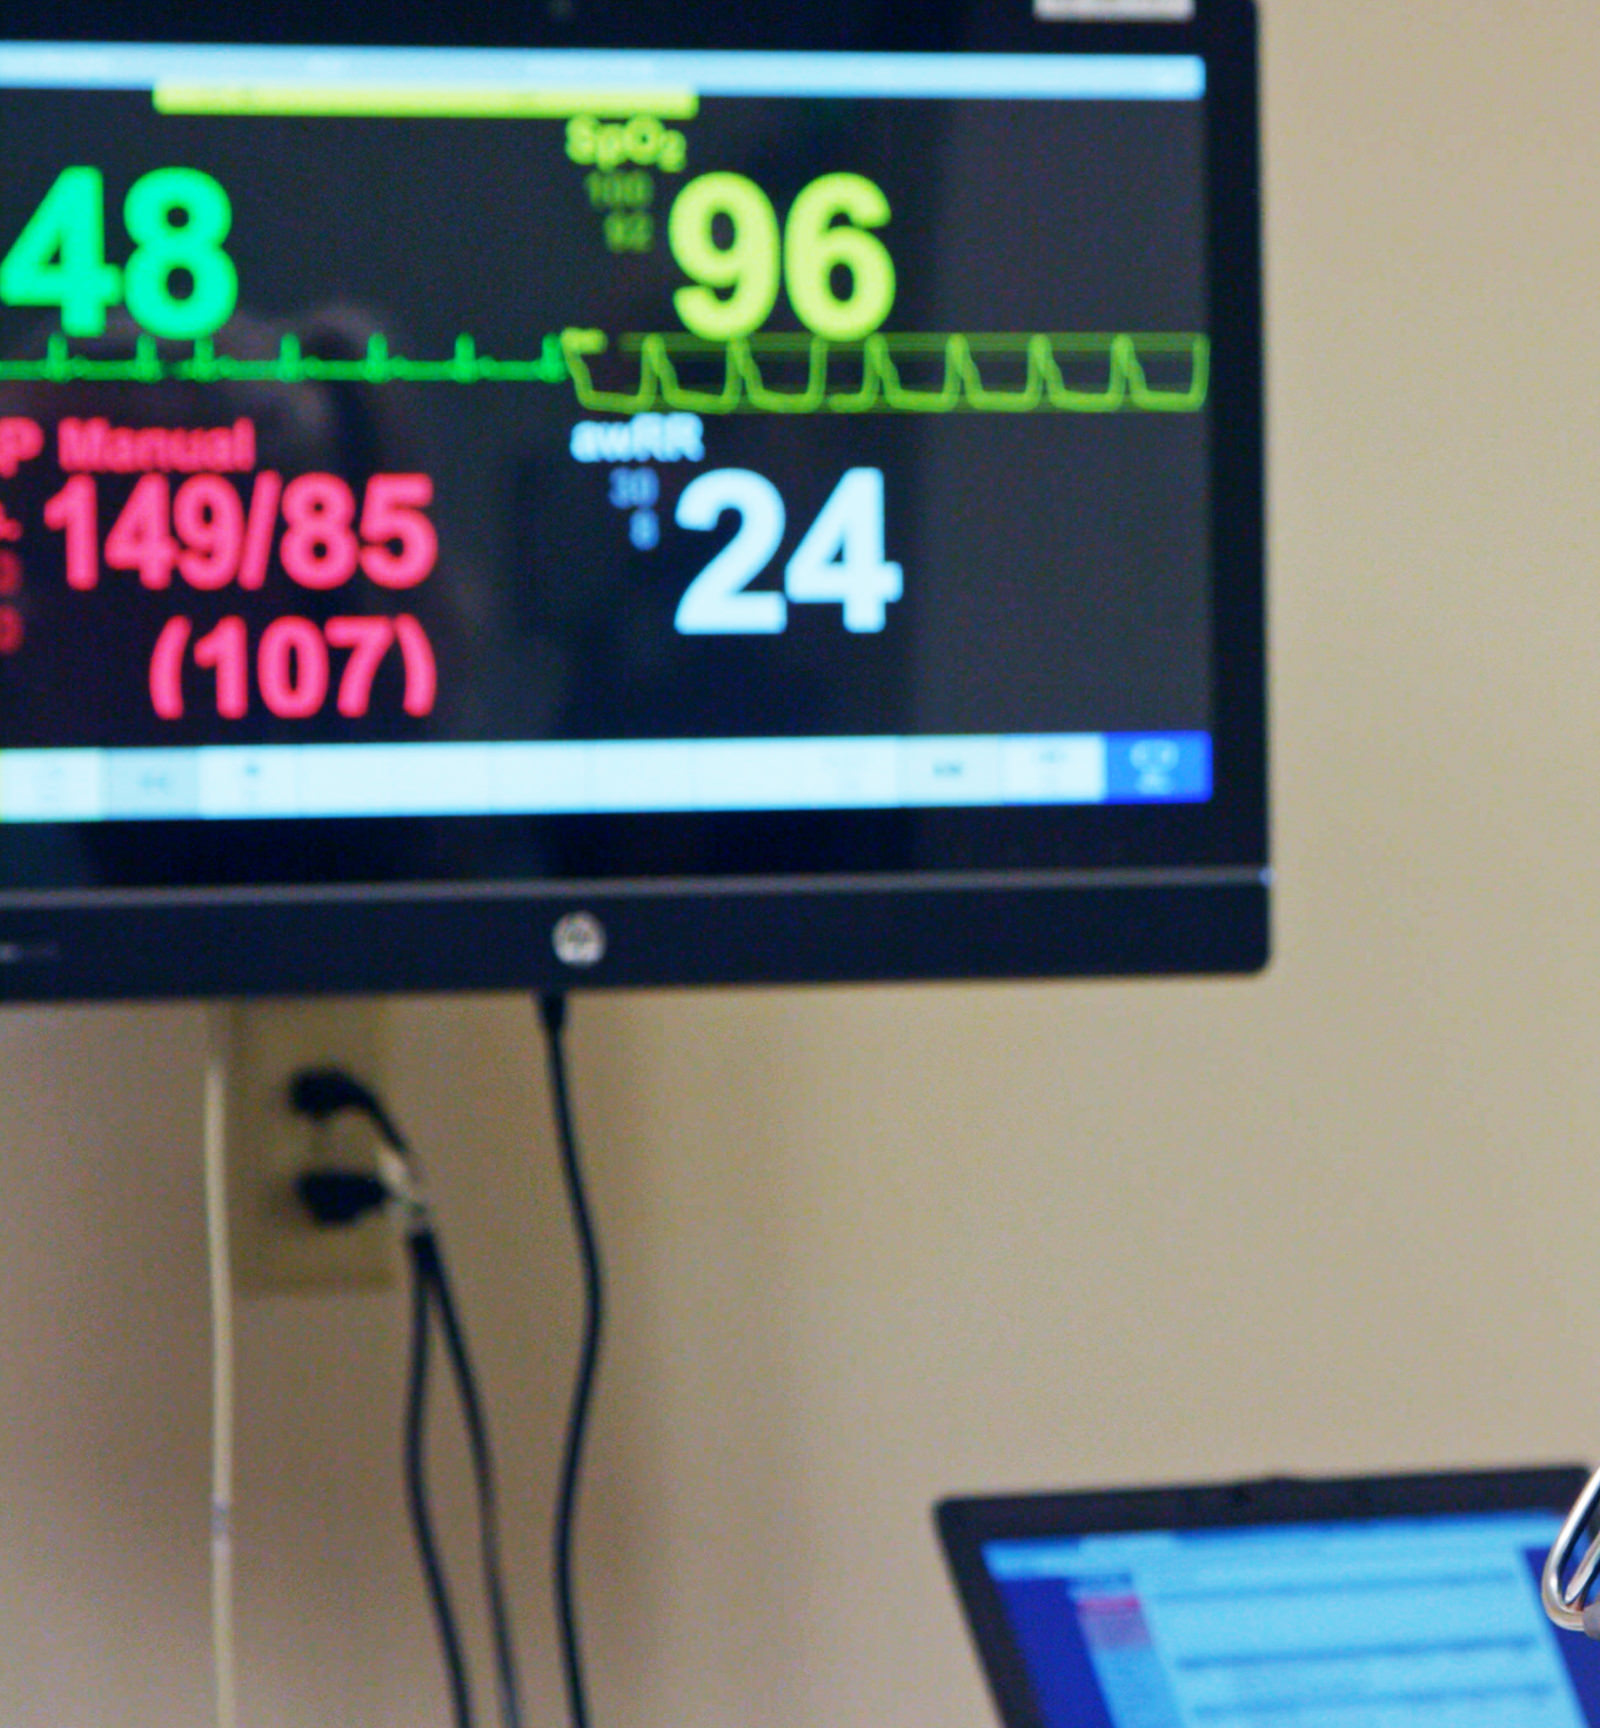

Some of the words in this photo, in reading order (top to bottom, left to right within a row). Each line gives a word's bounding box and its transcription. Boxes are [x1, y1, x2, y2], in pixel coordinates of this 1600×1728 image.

[668, 171, 896, 342] 96
[57, 416, 256, 473] Manual
[43, 470, 438, 591] 149/85
[674, 467, 903, 635] 24
[149, 613, 437, 720] (107)
